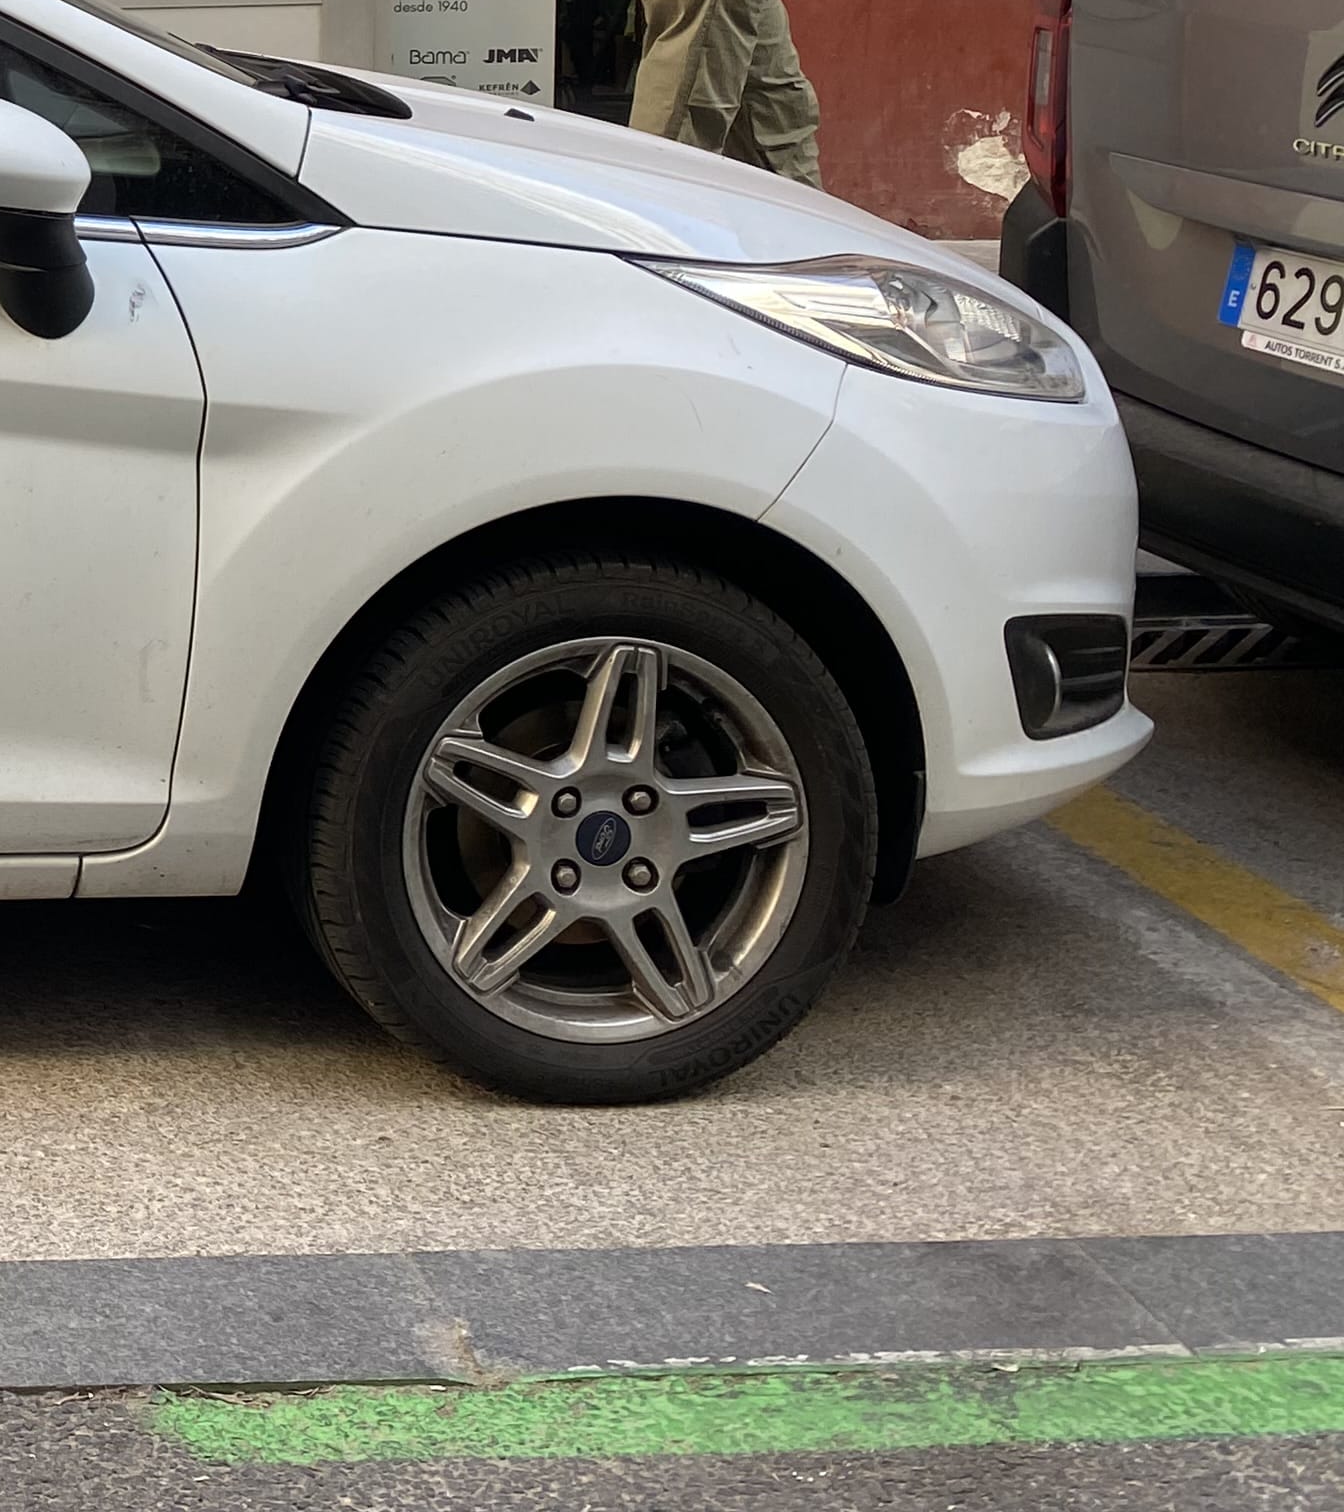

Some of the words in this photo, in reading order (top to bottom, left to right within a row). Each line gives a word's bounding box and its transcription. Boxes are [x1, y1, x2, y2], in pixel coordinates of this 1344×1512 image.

[393, 0, 434, 14] desde
[437, 0, 469, 12] 1940
[409, 49, 467, 65] Bama
[482, 48, 539, 64] JMA
[1226, 290, 1241, 308] E
[1264, 340, 1293, 357] AUTOS
[1294, 347, 1334, 367] TORRENT
[647, 991, 811, 1089] UNIROYAL
